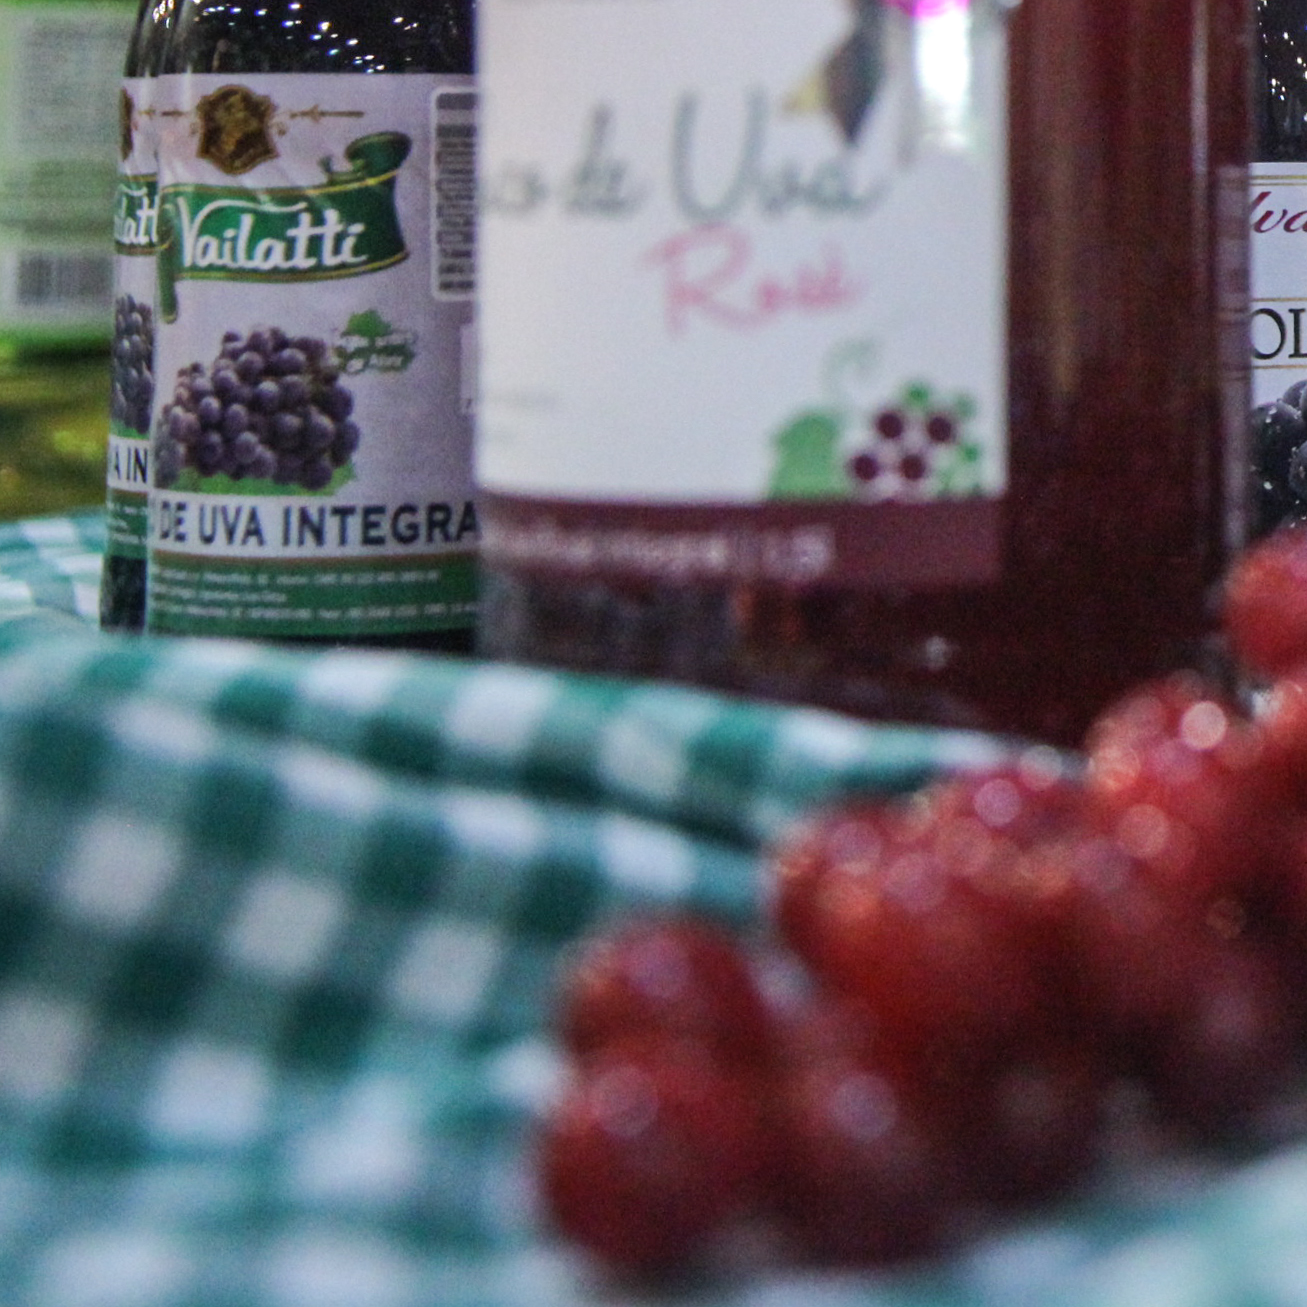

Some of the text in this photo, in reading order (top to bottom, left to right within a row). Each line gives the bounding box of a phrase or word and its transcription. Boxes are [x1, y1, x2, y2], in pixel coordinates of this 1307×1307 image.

[177, 197, 368, 270] Vailatti
[159, 500, 187, 542] DE
[200, 505, 265, 547] UVA
[281, 500, 479, 547] INTEGRA
